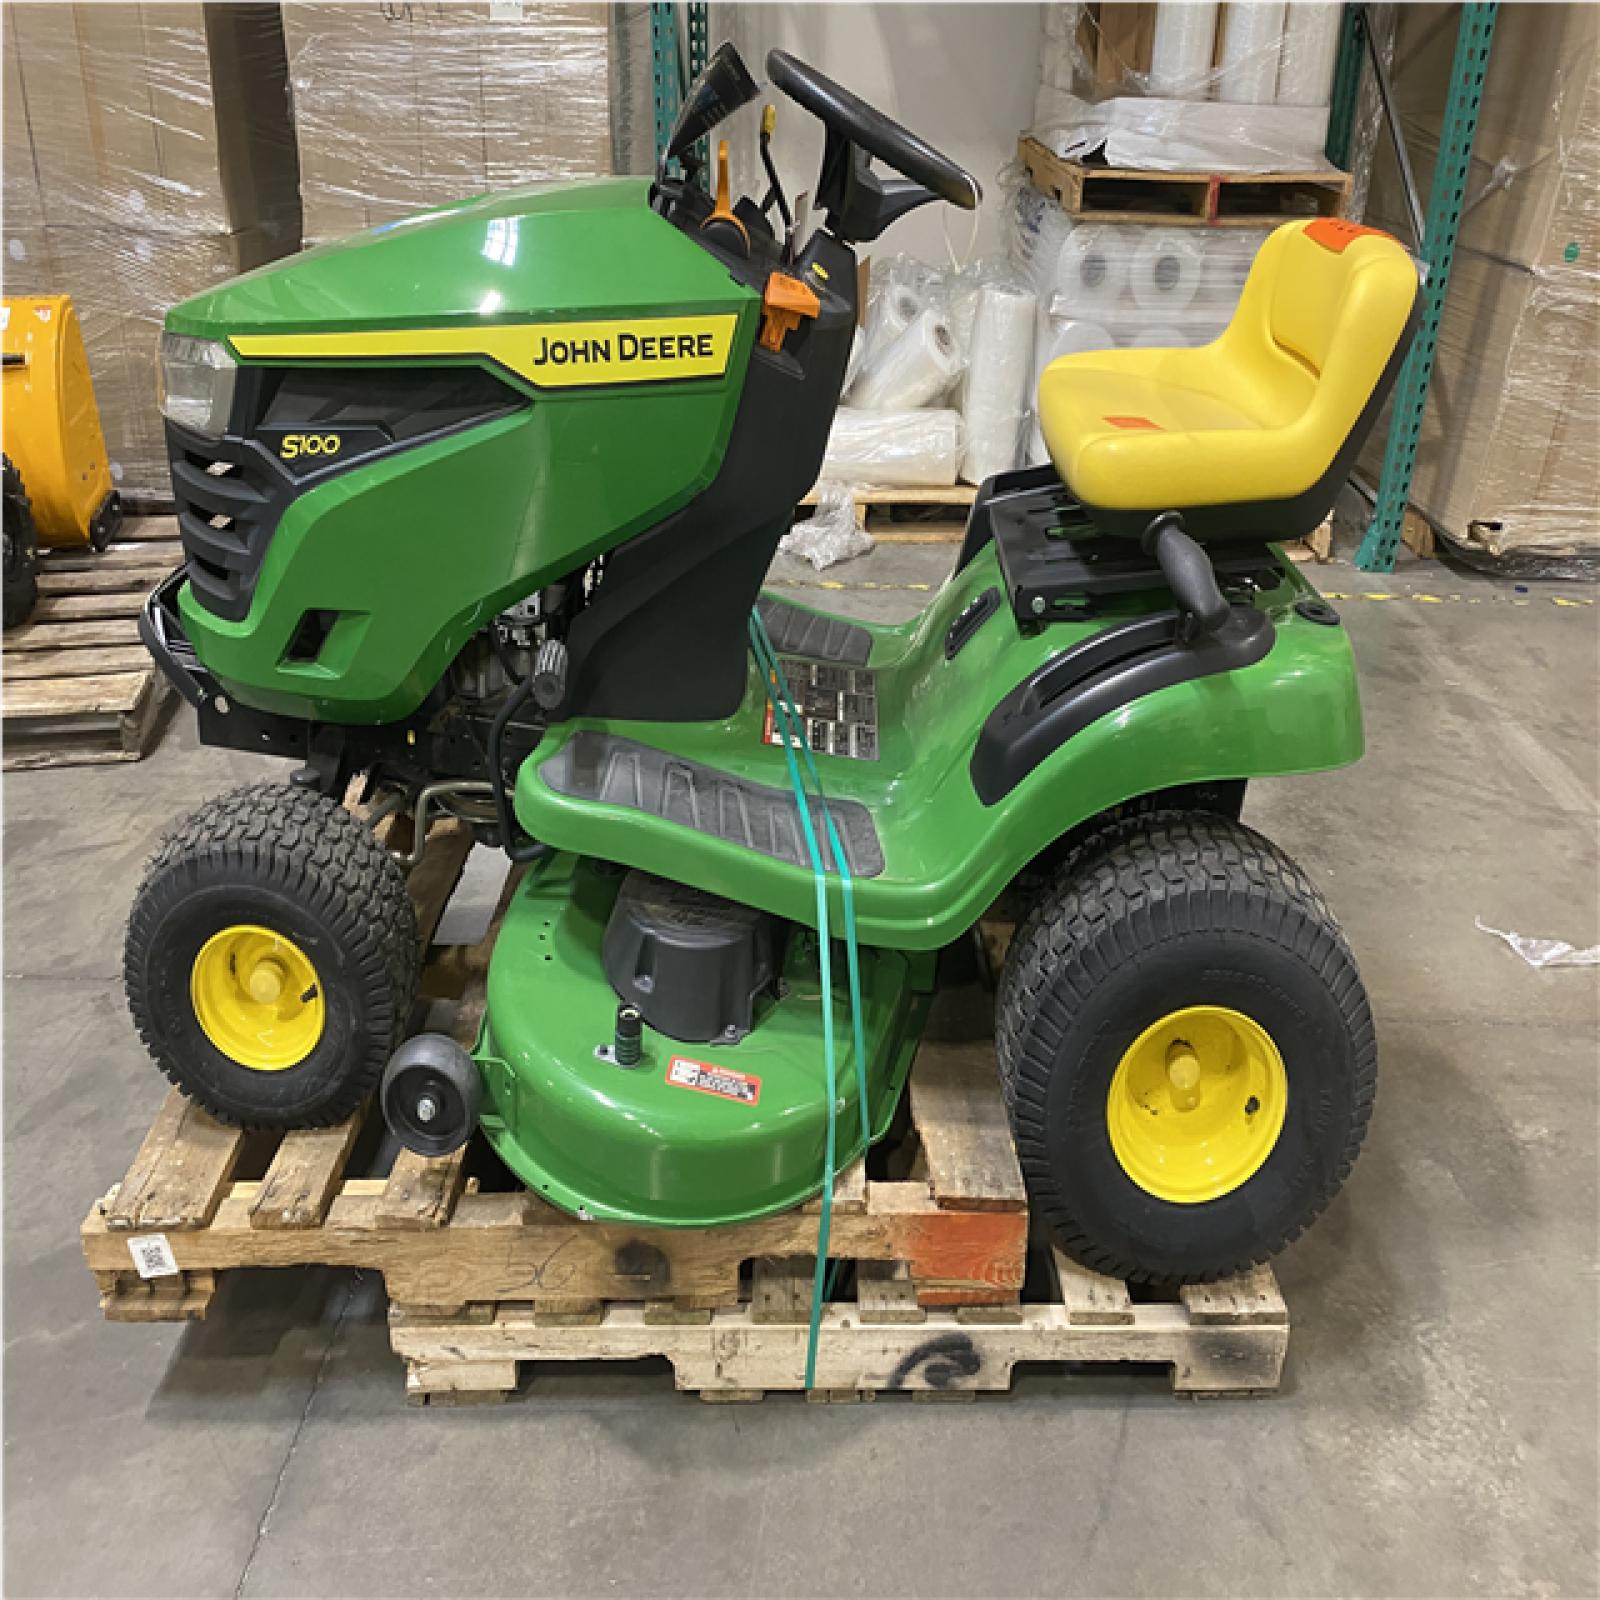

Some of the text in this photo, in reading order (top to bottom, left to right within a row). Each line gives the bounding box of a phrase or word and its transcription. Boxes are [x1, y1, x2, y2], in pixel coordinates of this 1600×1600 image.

[533, 333, 714, 366] JOHN DEERE
[280, 433, 341, 459] S100
